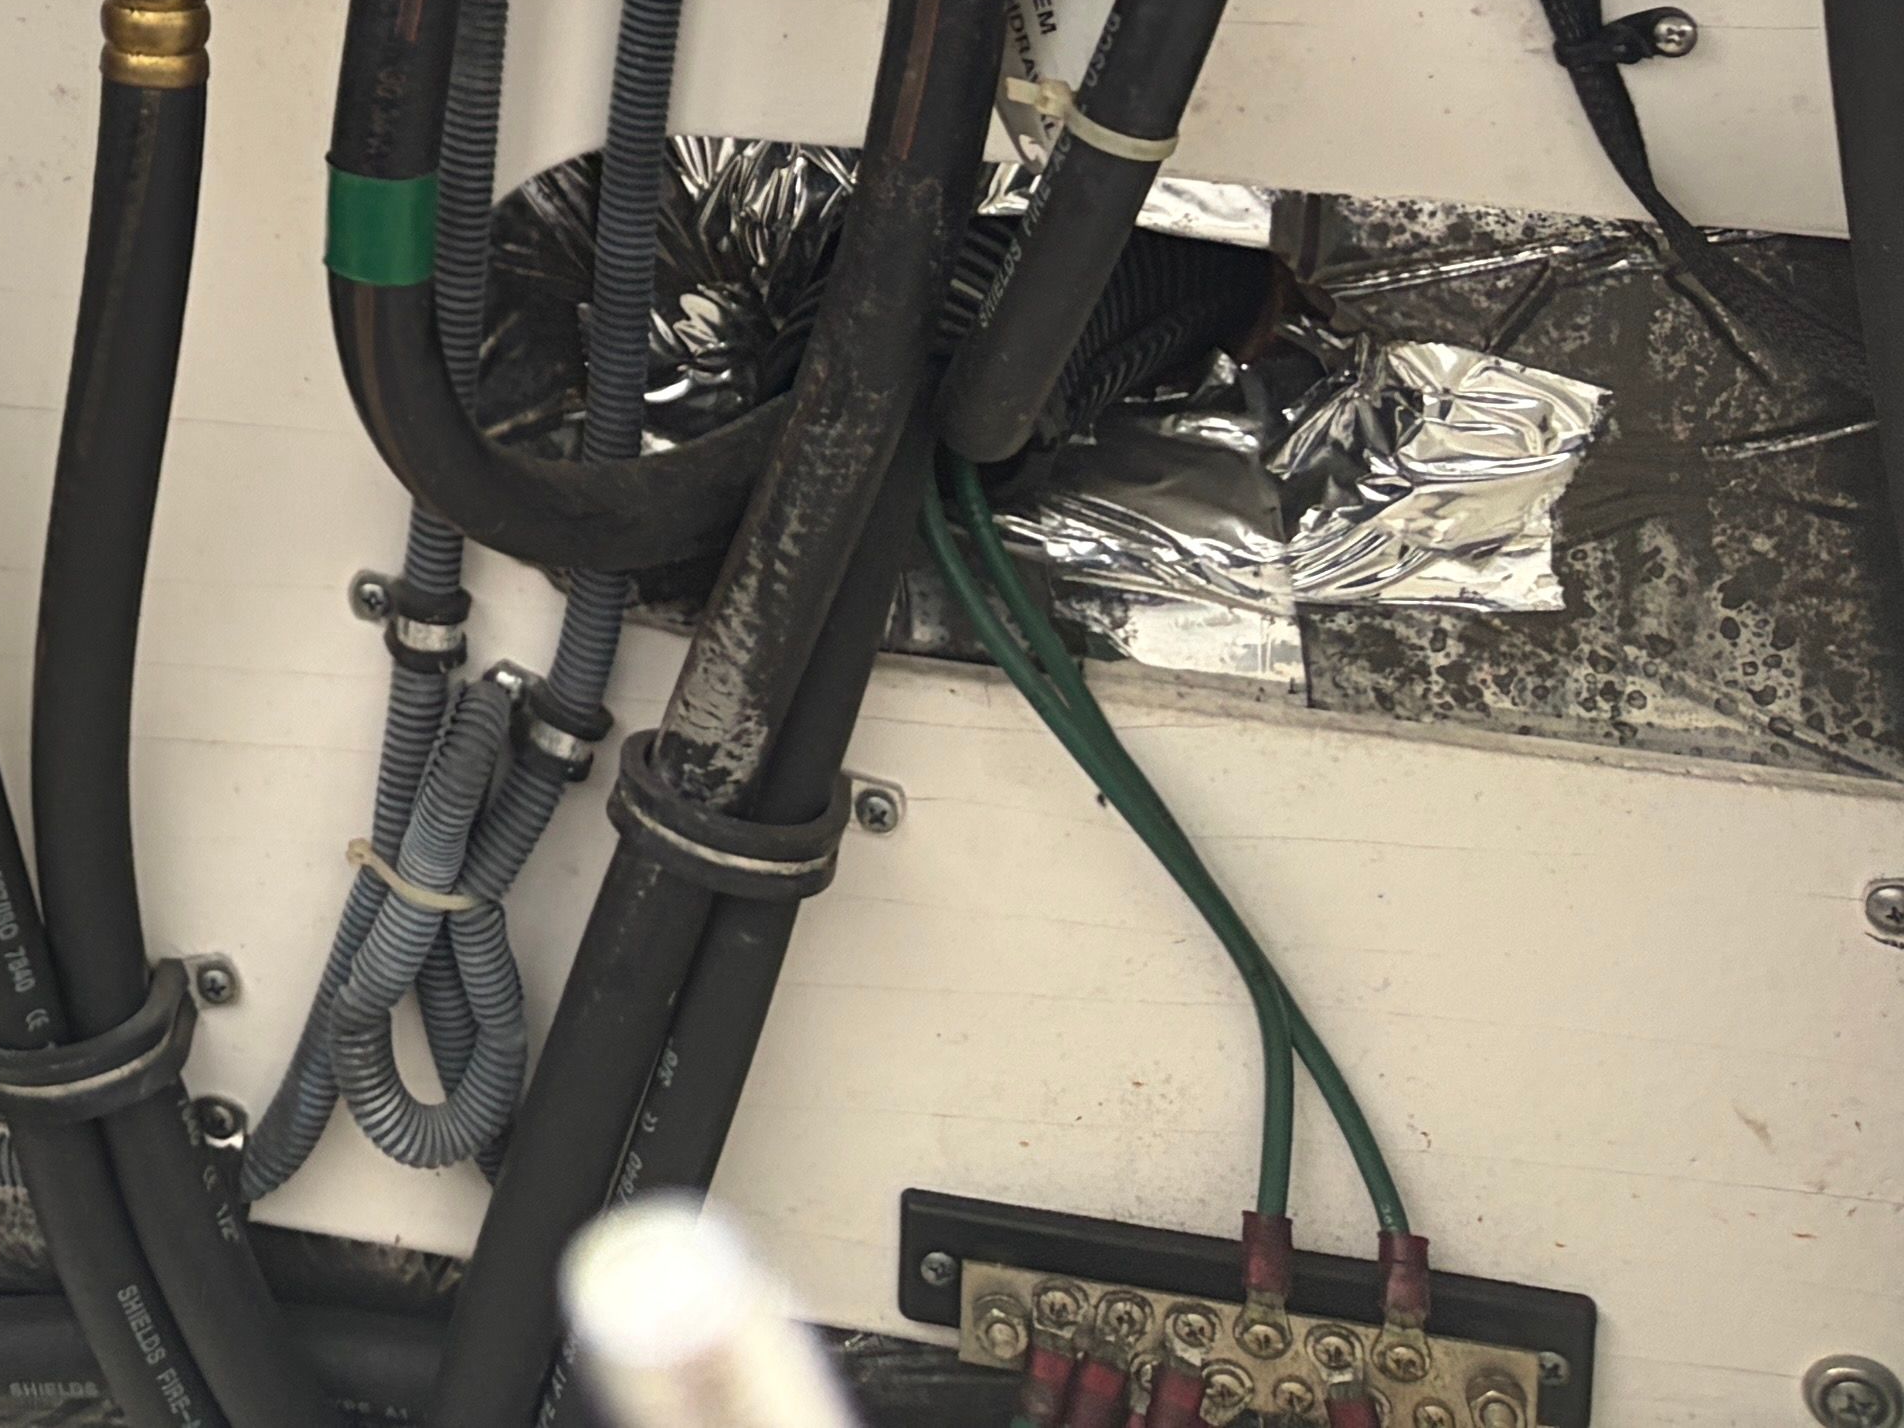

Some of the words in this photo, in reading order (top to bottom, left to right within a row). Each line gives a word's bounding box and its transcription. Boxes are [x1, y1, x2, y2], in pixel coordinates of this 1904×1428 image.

[4, 945, 37, 994] 7840
[117, 1284, 167, 1365] SHIELDS
[8, 1381, 101, 1398] SHIELDS
